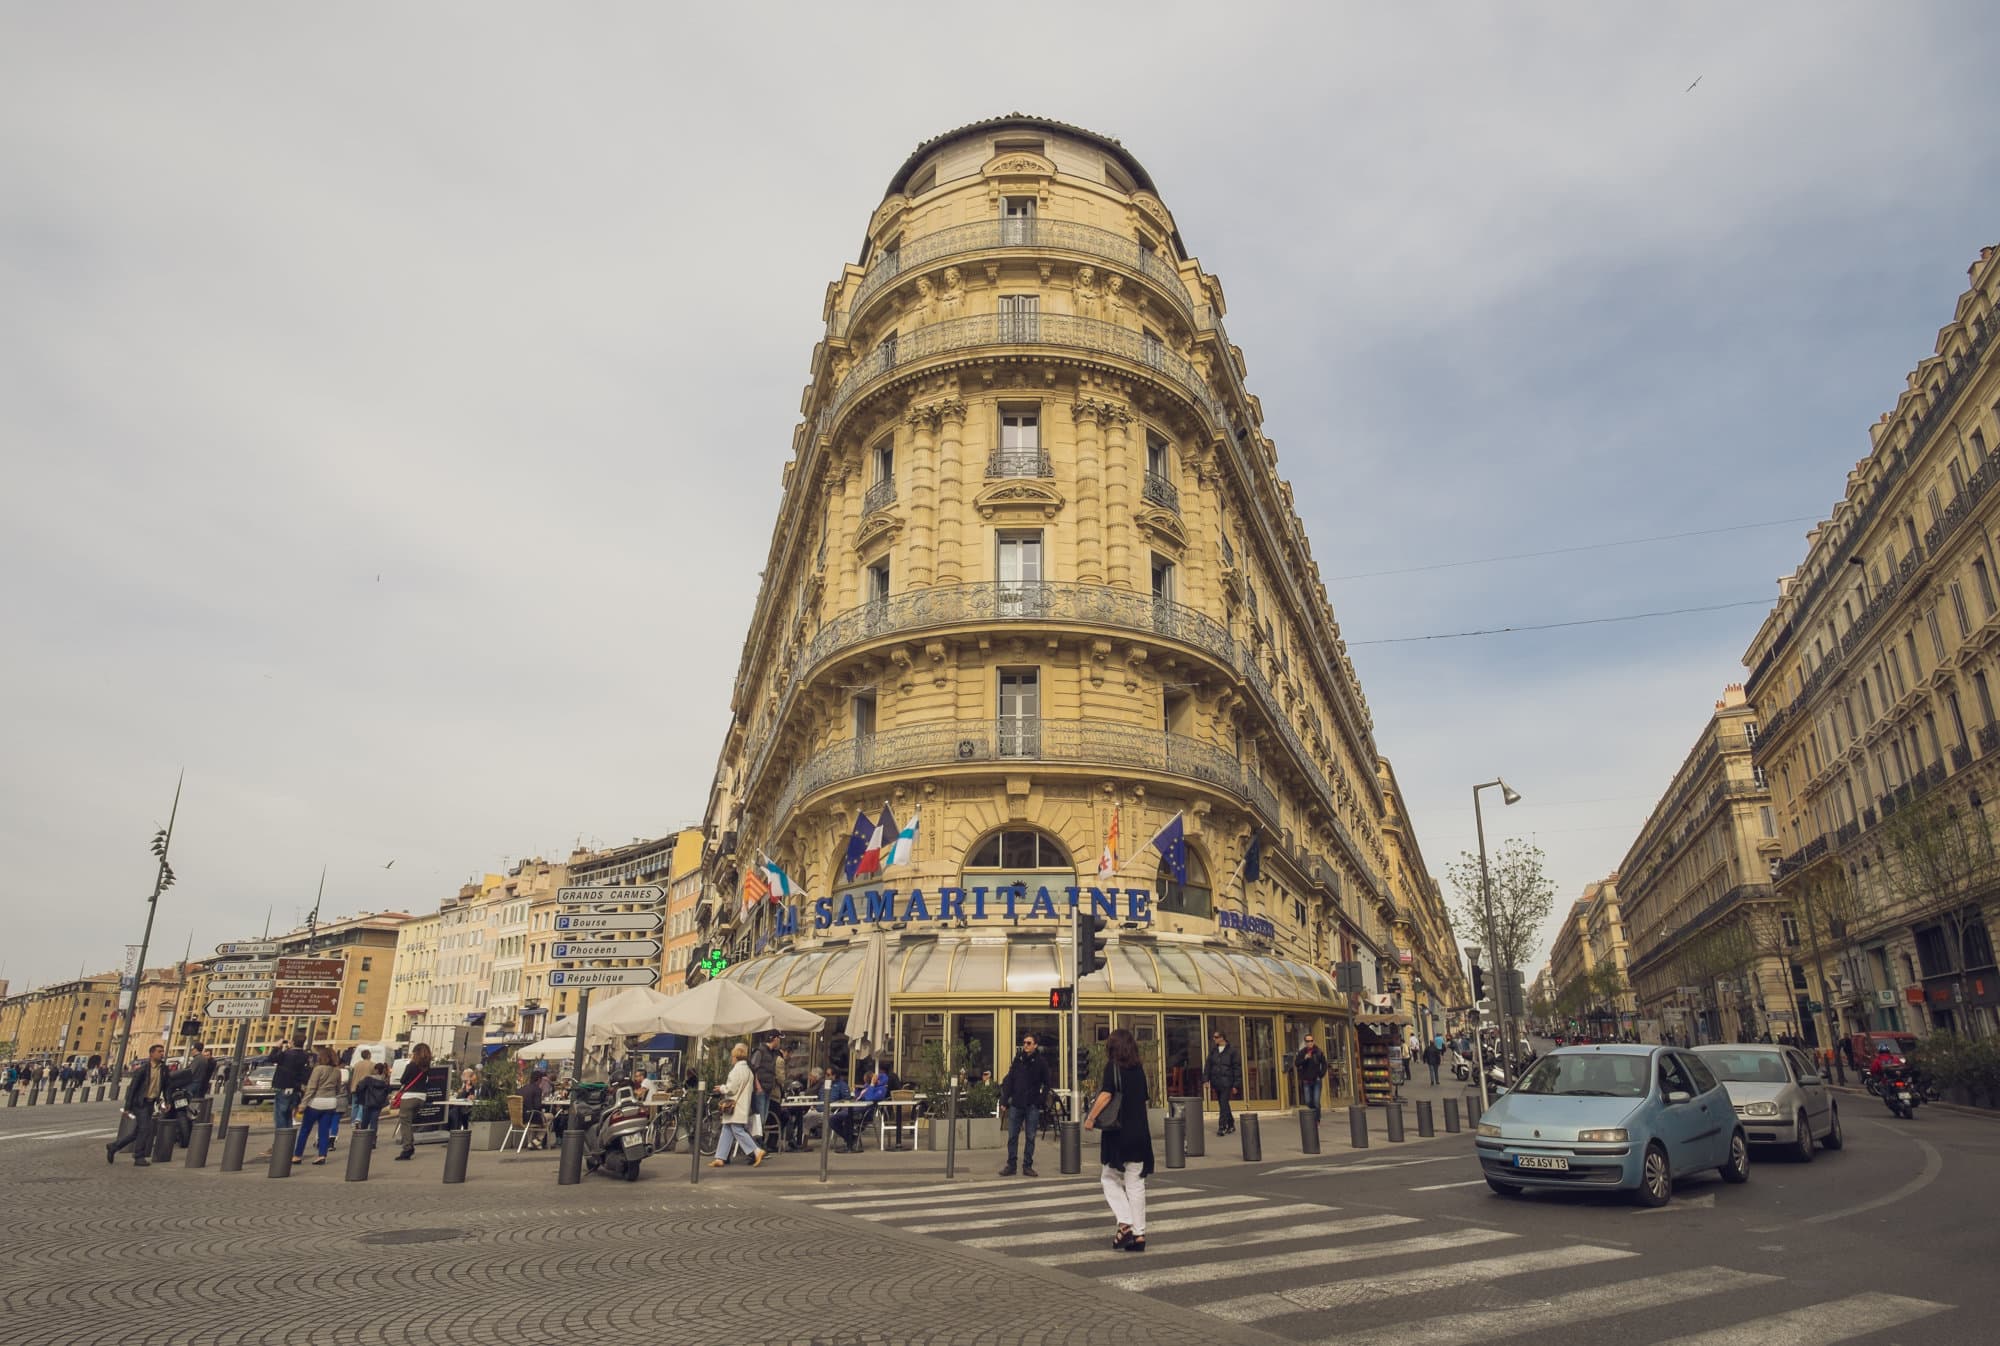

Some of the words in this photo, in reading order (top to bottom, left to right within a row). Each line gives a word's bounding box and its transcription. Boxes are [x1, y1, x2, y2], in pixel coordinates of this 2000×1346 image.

[562, 890, 604, 901] GRANDS
[609, 889, 652, 899] CARMES
[815, 885, 1152, 930] SAMARITAINE
[572, 918, 607, 927] Bourse
[1219, 910, 1275, 939] BRASSER
[569, 944, 617, 955] Phocéens
[567, 973, 624, 984] République
[1519, 1156, 1536, 1167] 235
[1537, 1157, 1553, 1168] ASV
[1555, 1158, 1567, 1169] 13
